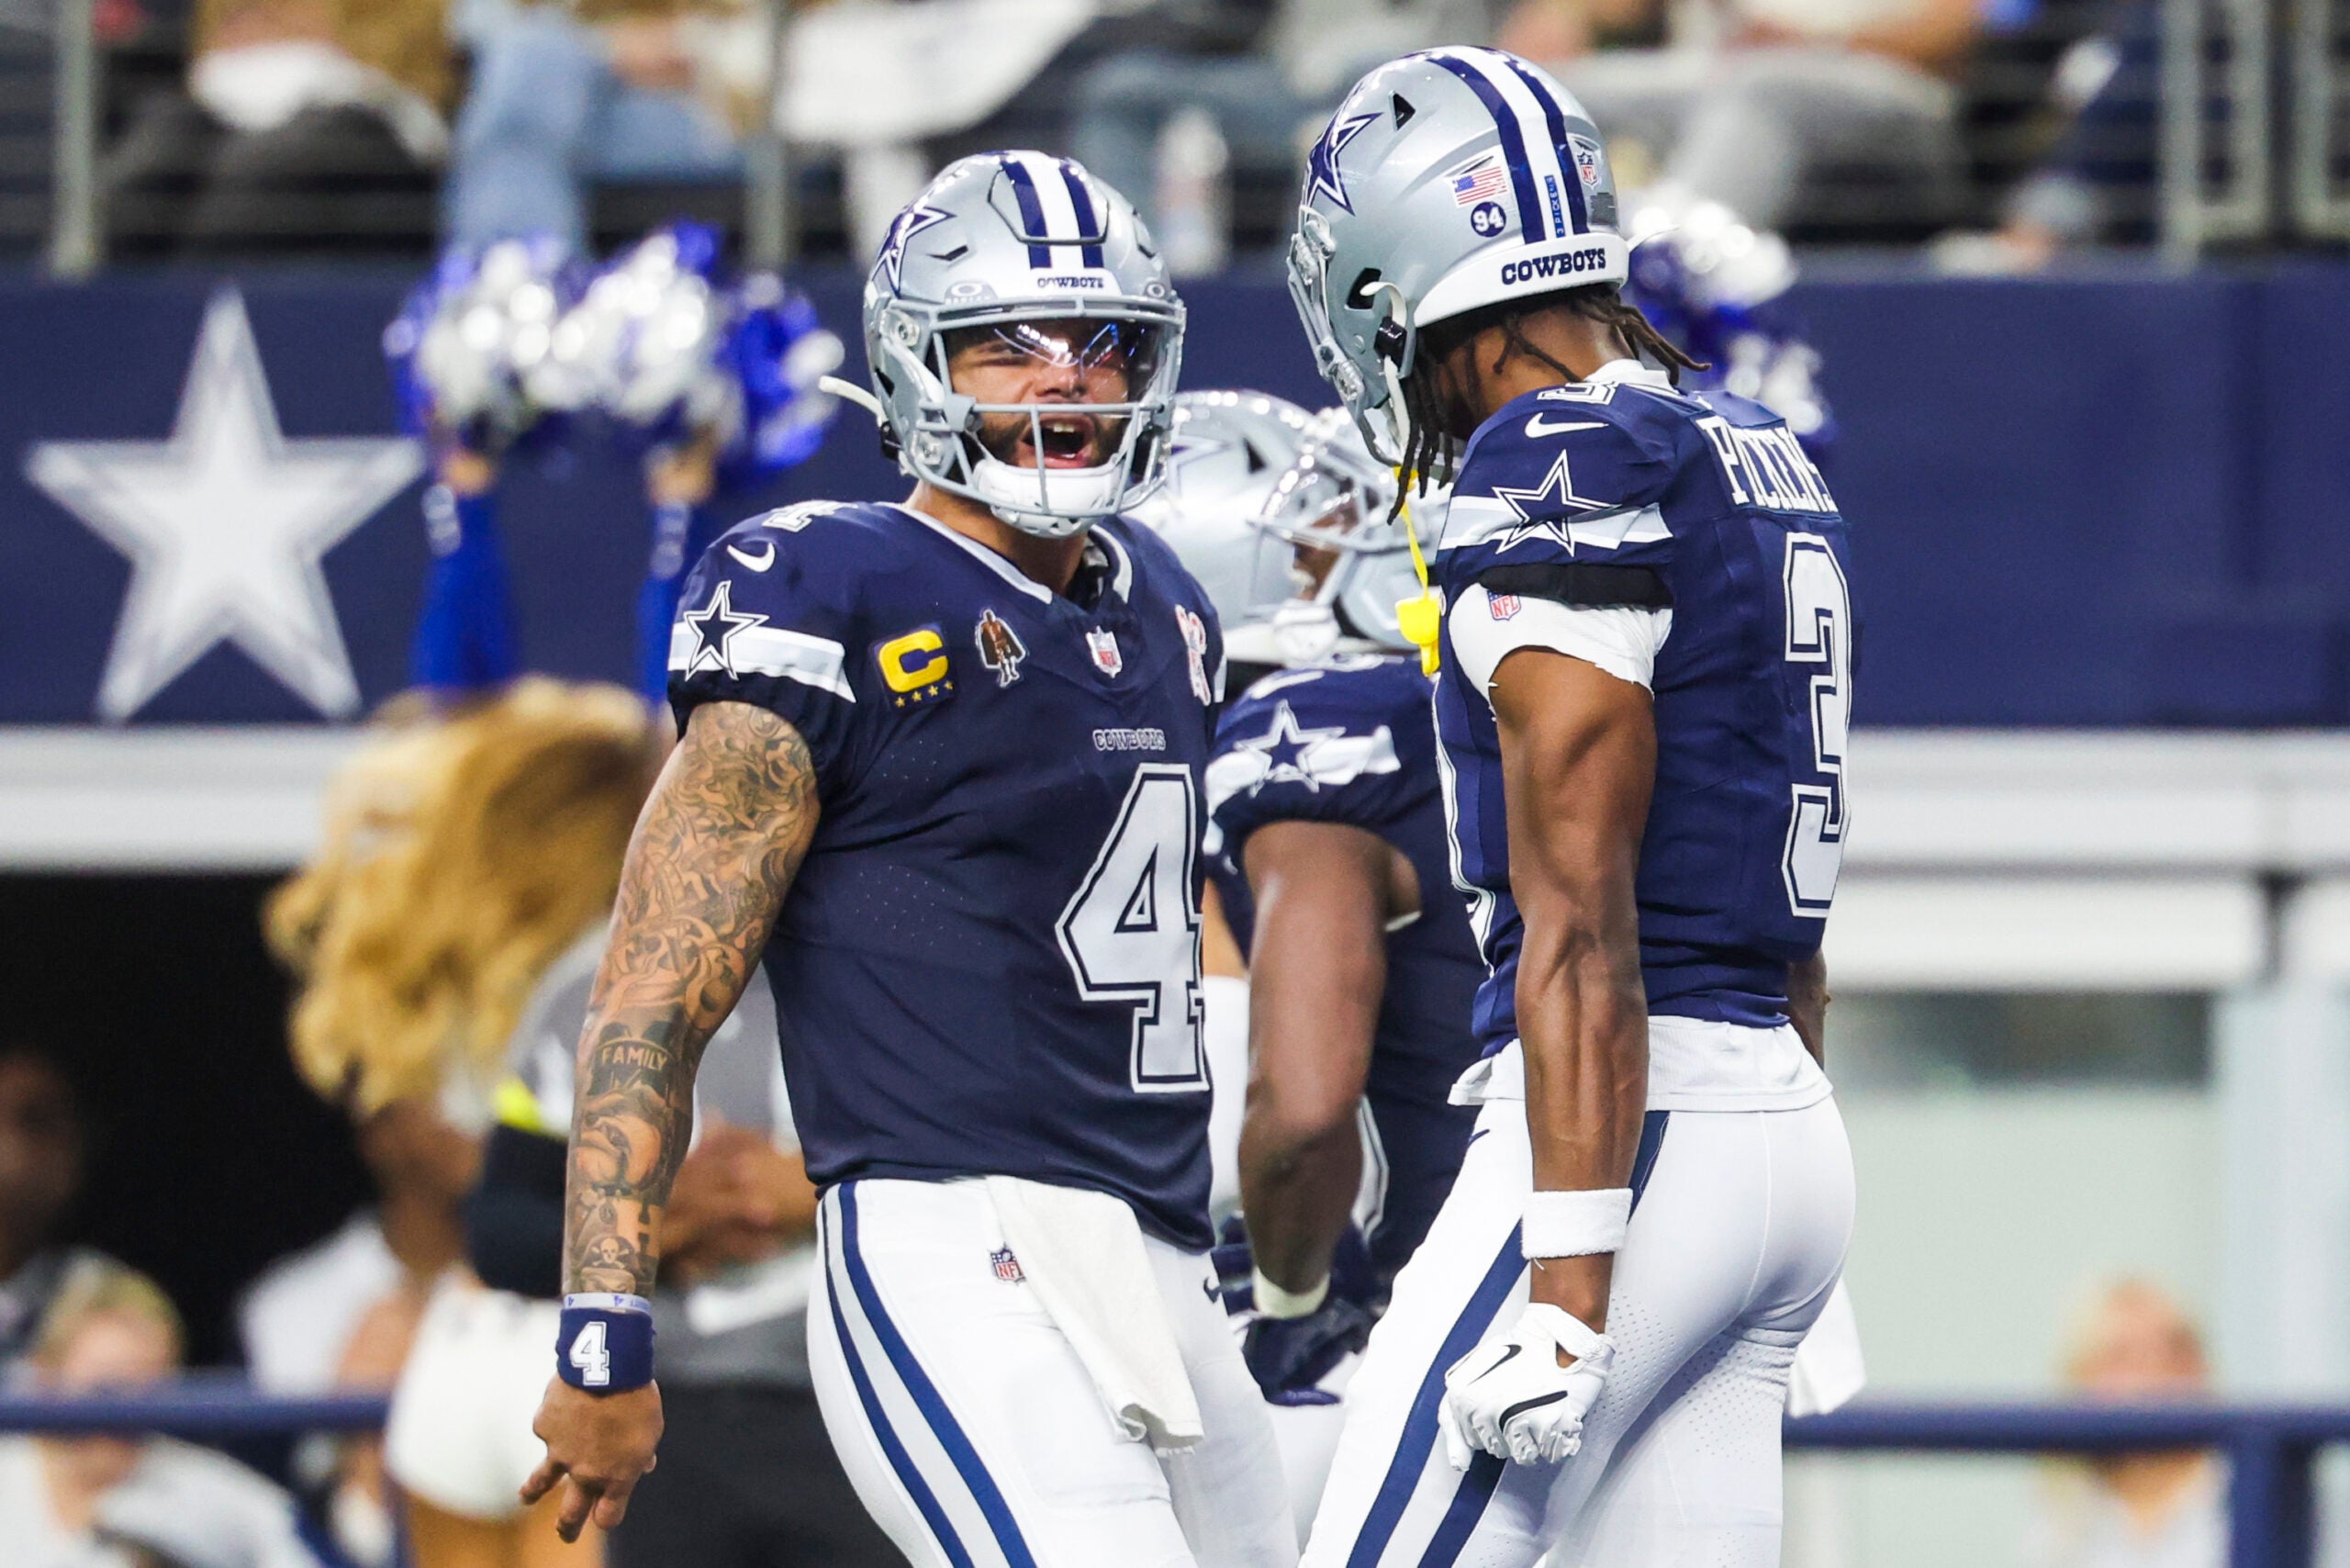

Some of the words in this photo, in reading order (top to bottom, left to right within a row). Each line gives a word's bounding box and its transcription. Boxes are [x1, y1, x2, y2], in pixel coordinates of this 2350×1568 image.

[1473, 207, 1505, 232] 94
[1501, 248, 1606, 286] COWBOYS
[1492, 594, 1519, 618] NFL
[878, 630, 949, 693] C
[1092, 728, 1167, 752] COWBOYS
[1781, 531, 1852, 918] 3
[1055, 763, 1211, 1093] 4
[601, 1046, 668, 1072] FAMILY
[569, 1321, 610, 1386] 4
